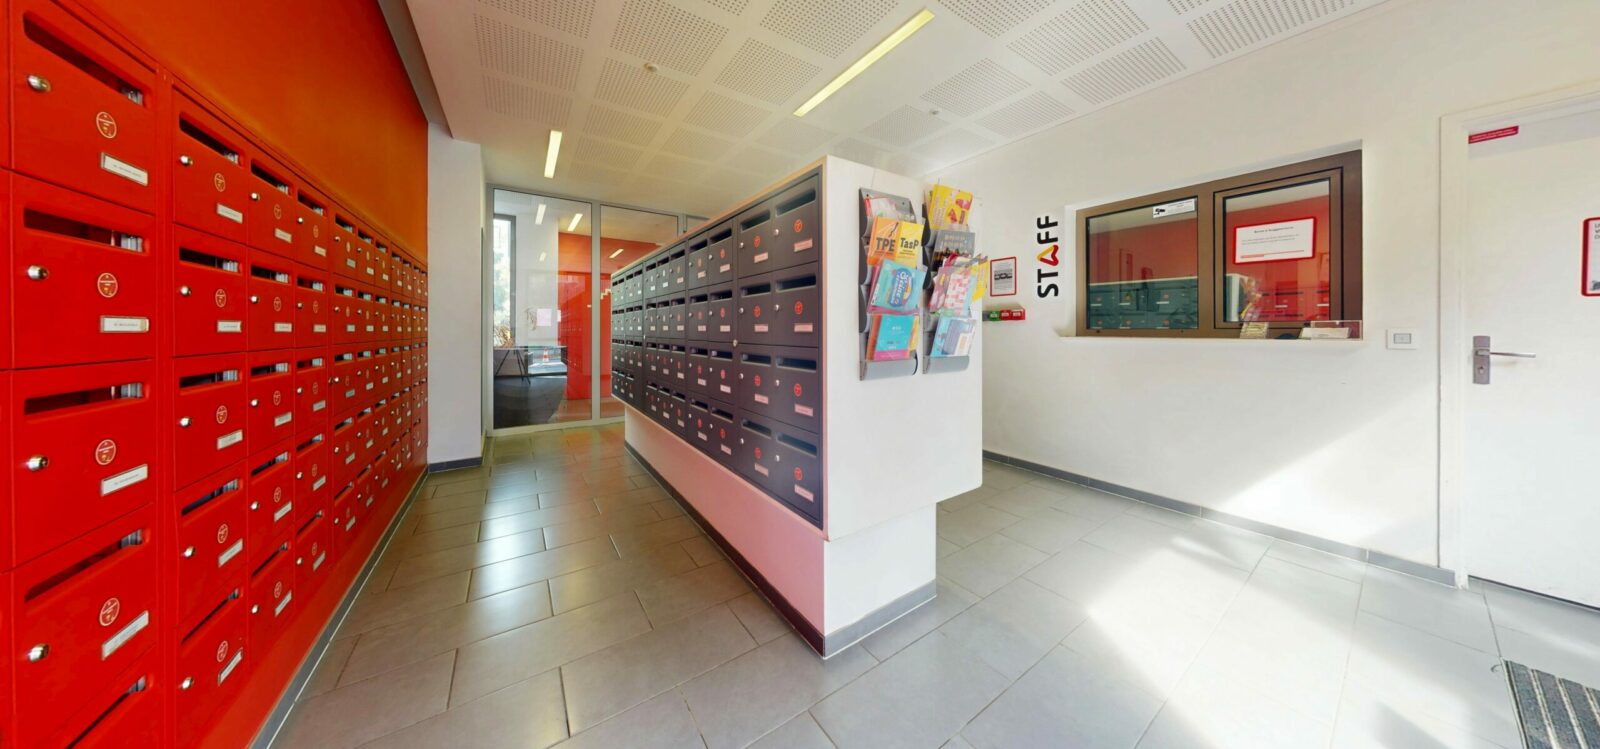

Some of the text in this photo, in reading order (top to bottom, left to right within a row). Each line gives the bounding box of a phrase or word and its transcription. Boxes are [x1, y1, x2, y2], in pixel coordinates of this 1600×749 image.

[876, 237, 896, 252] TPE
[900, 237, 919, 250] TasP
[1036, 215, 1059, 298] STAFF
